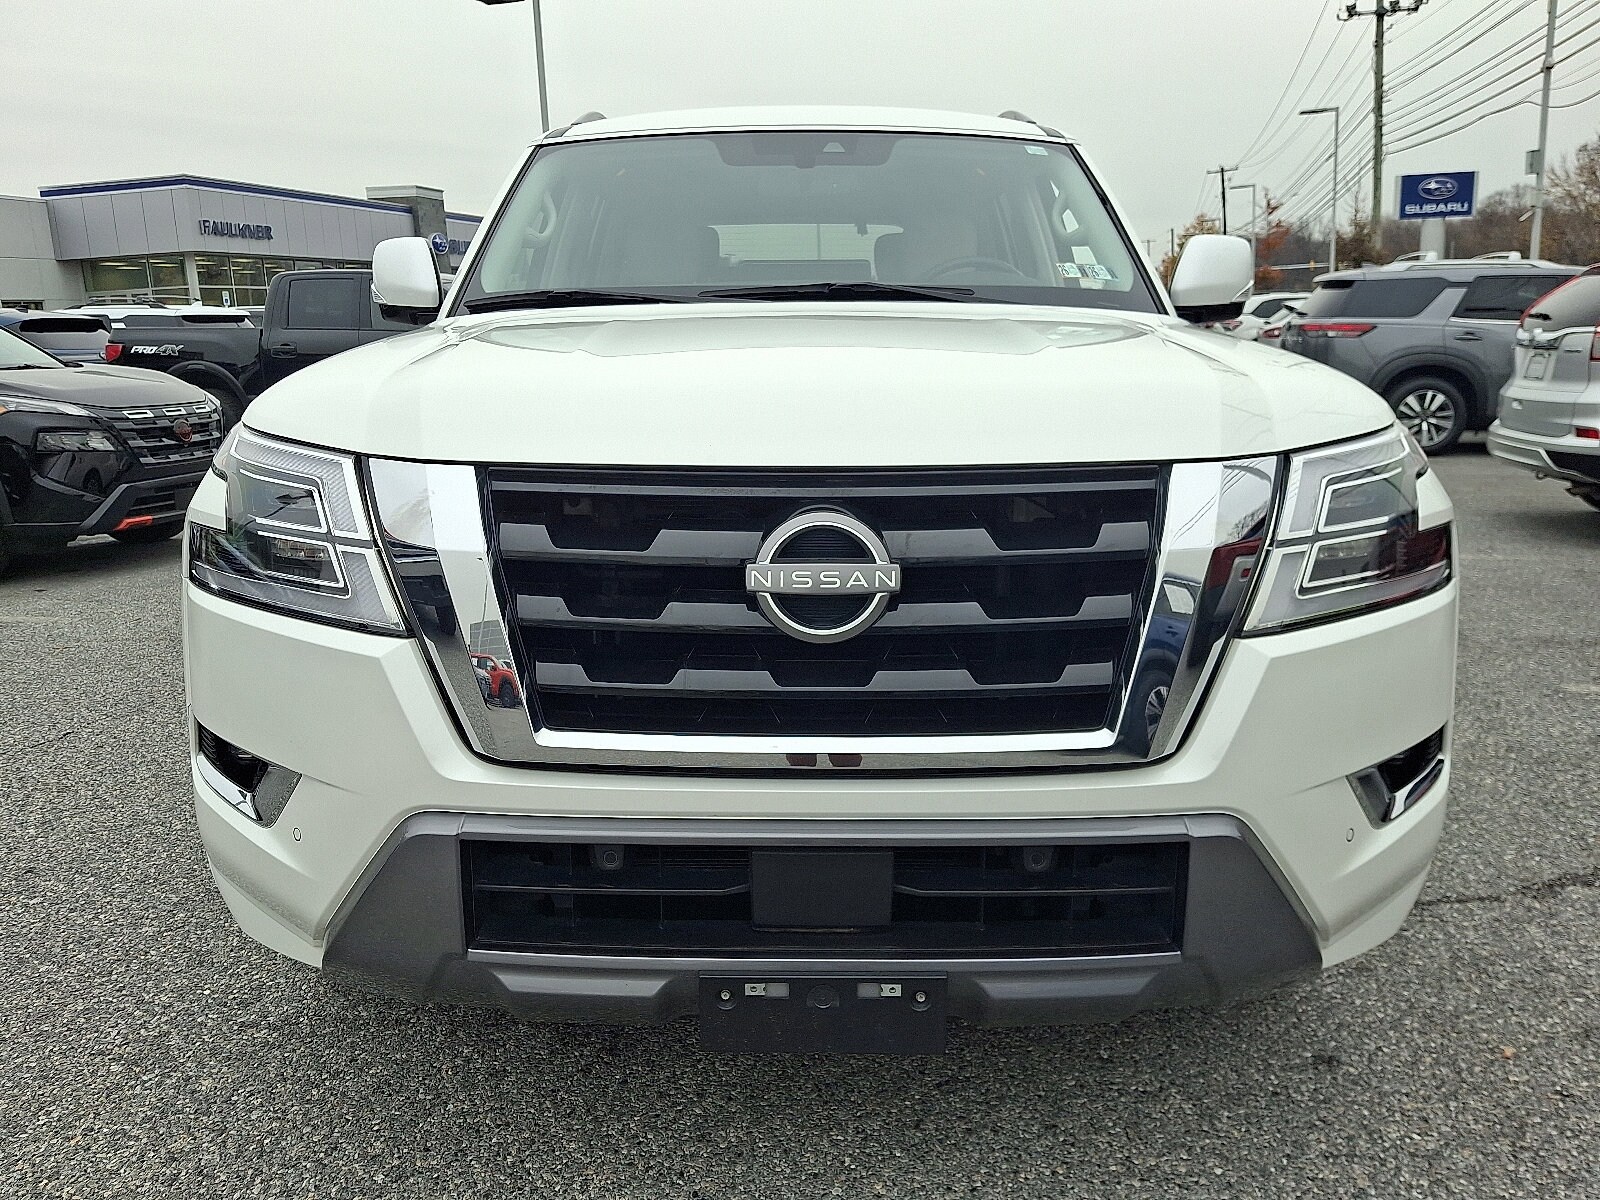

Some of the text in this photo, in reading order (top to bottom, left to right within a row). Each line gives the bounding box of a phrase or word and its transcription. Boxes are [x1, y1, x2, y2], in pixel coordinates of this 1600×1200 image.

[1404, 201, 1469, 215] SUBARU
[199, 219, 273, 240] FAULKNER
[751, 570, 896, 588] NISSAN
